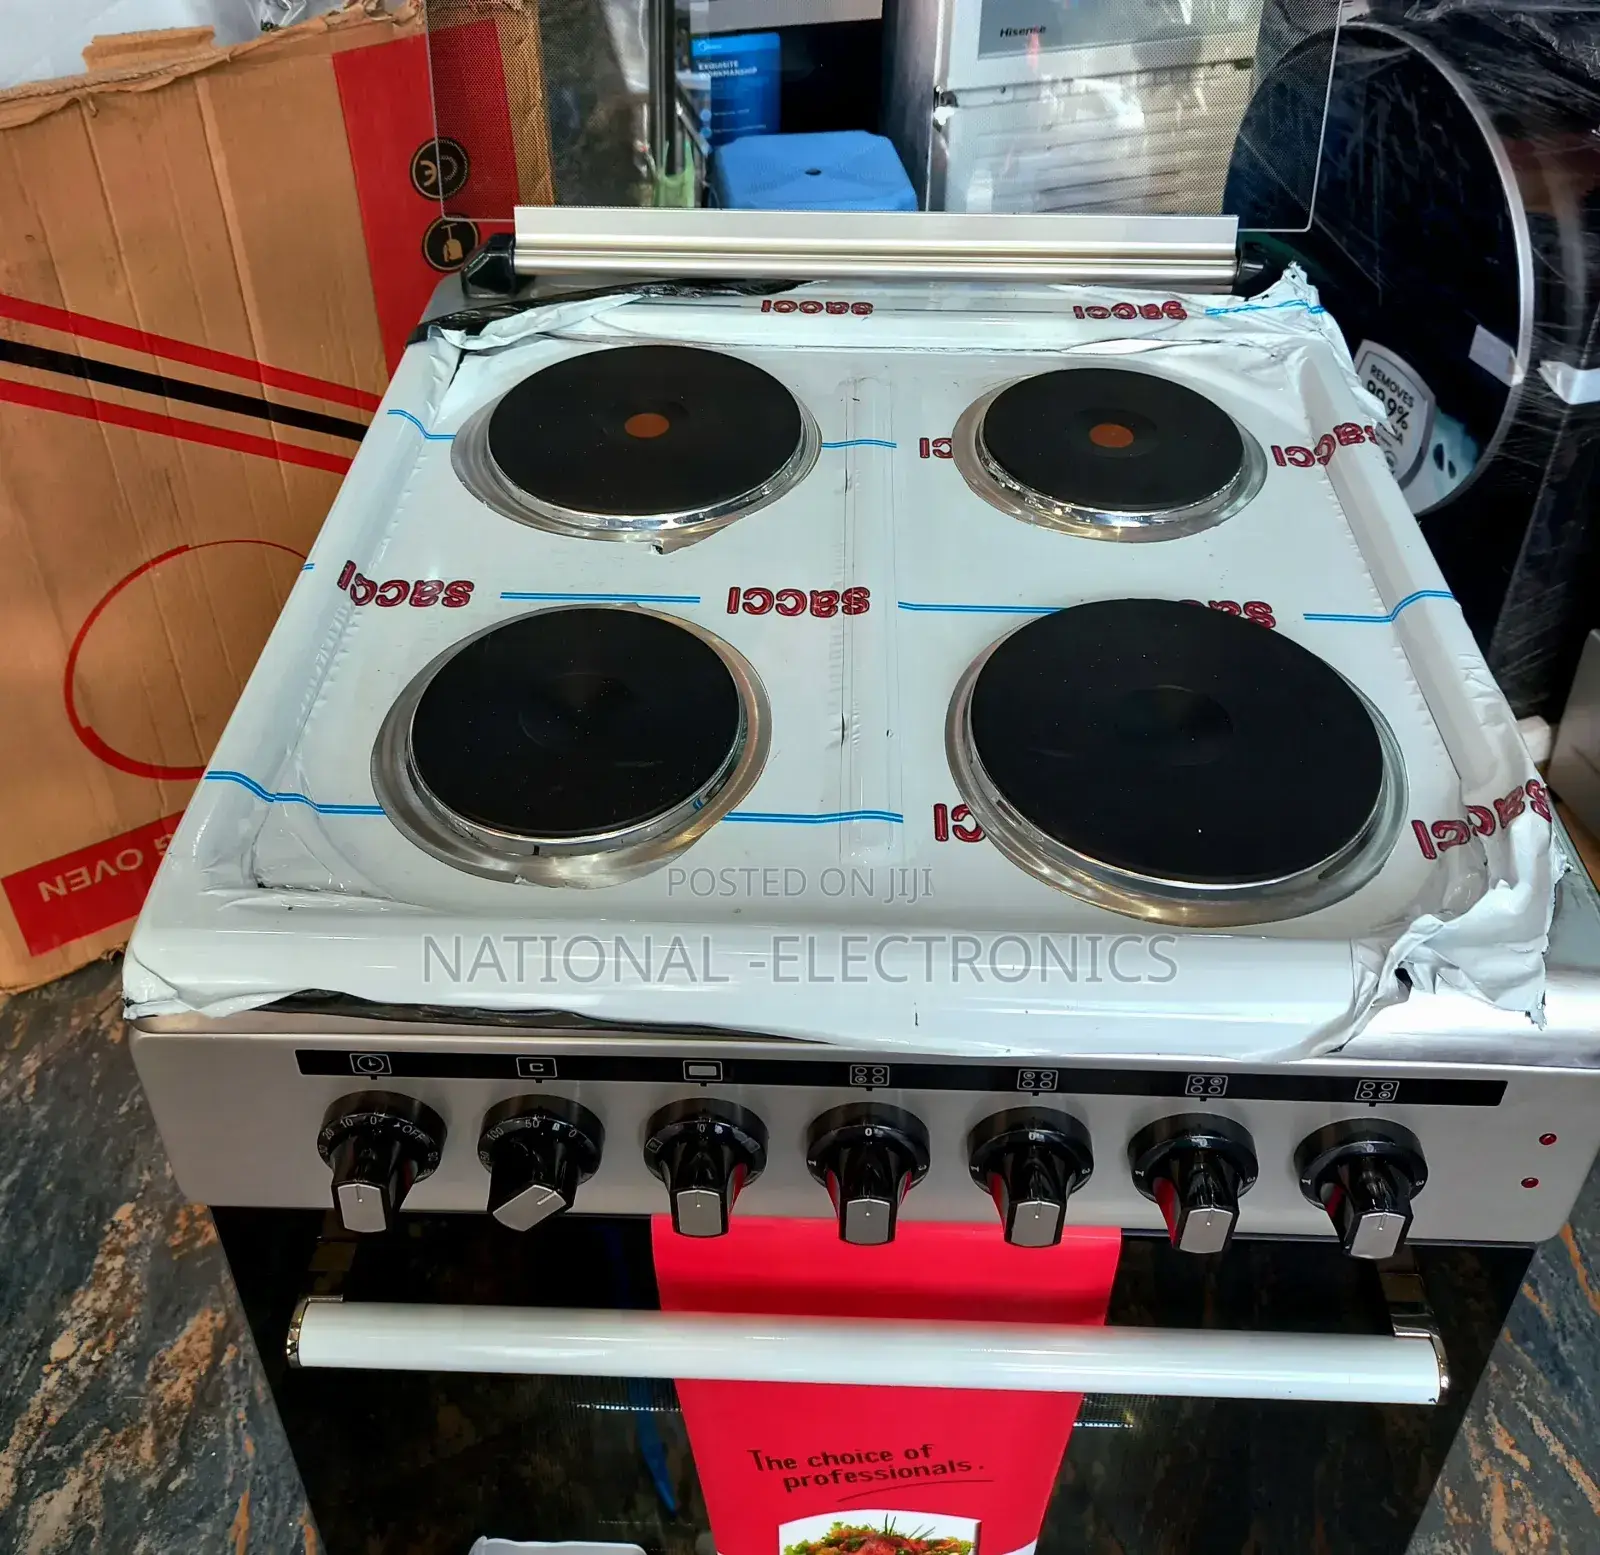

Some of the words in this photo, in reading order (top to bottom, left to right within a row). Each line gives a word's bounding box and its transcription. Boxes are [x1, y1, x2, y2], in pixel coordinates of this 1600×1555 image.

[1000, 25, 1046, 38] Hisense
[697, 60, 739, 71] EXQUISITE
[1370, 364, 1415, 408] REMOVES
[1366, 379, 1409, 431] 999%
[37, 848, 144, 903] OVEN
[340, 1117, 354, 1128] 10
[525, 1119, 540, 1128] 50
[402, 1124, 427, 1140] OFF
[487, 1126, 504, 1140] 100
[568, 1129, 577, 1138] 0
[865, 1127, 873, 1137] 0
[747, 1450, 798, 1472] The
[808, 1449, 894, 1468] choice
[904, 1443, 935, 1461] of
